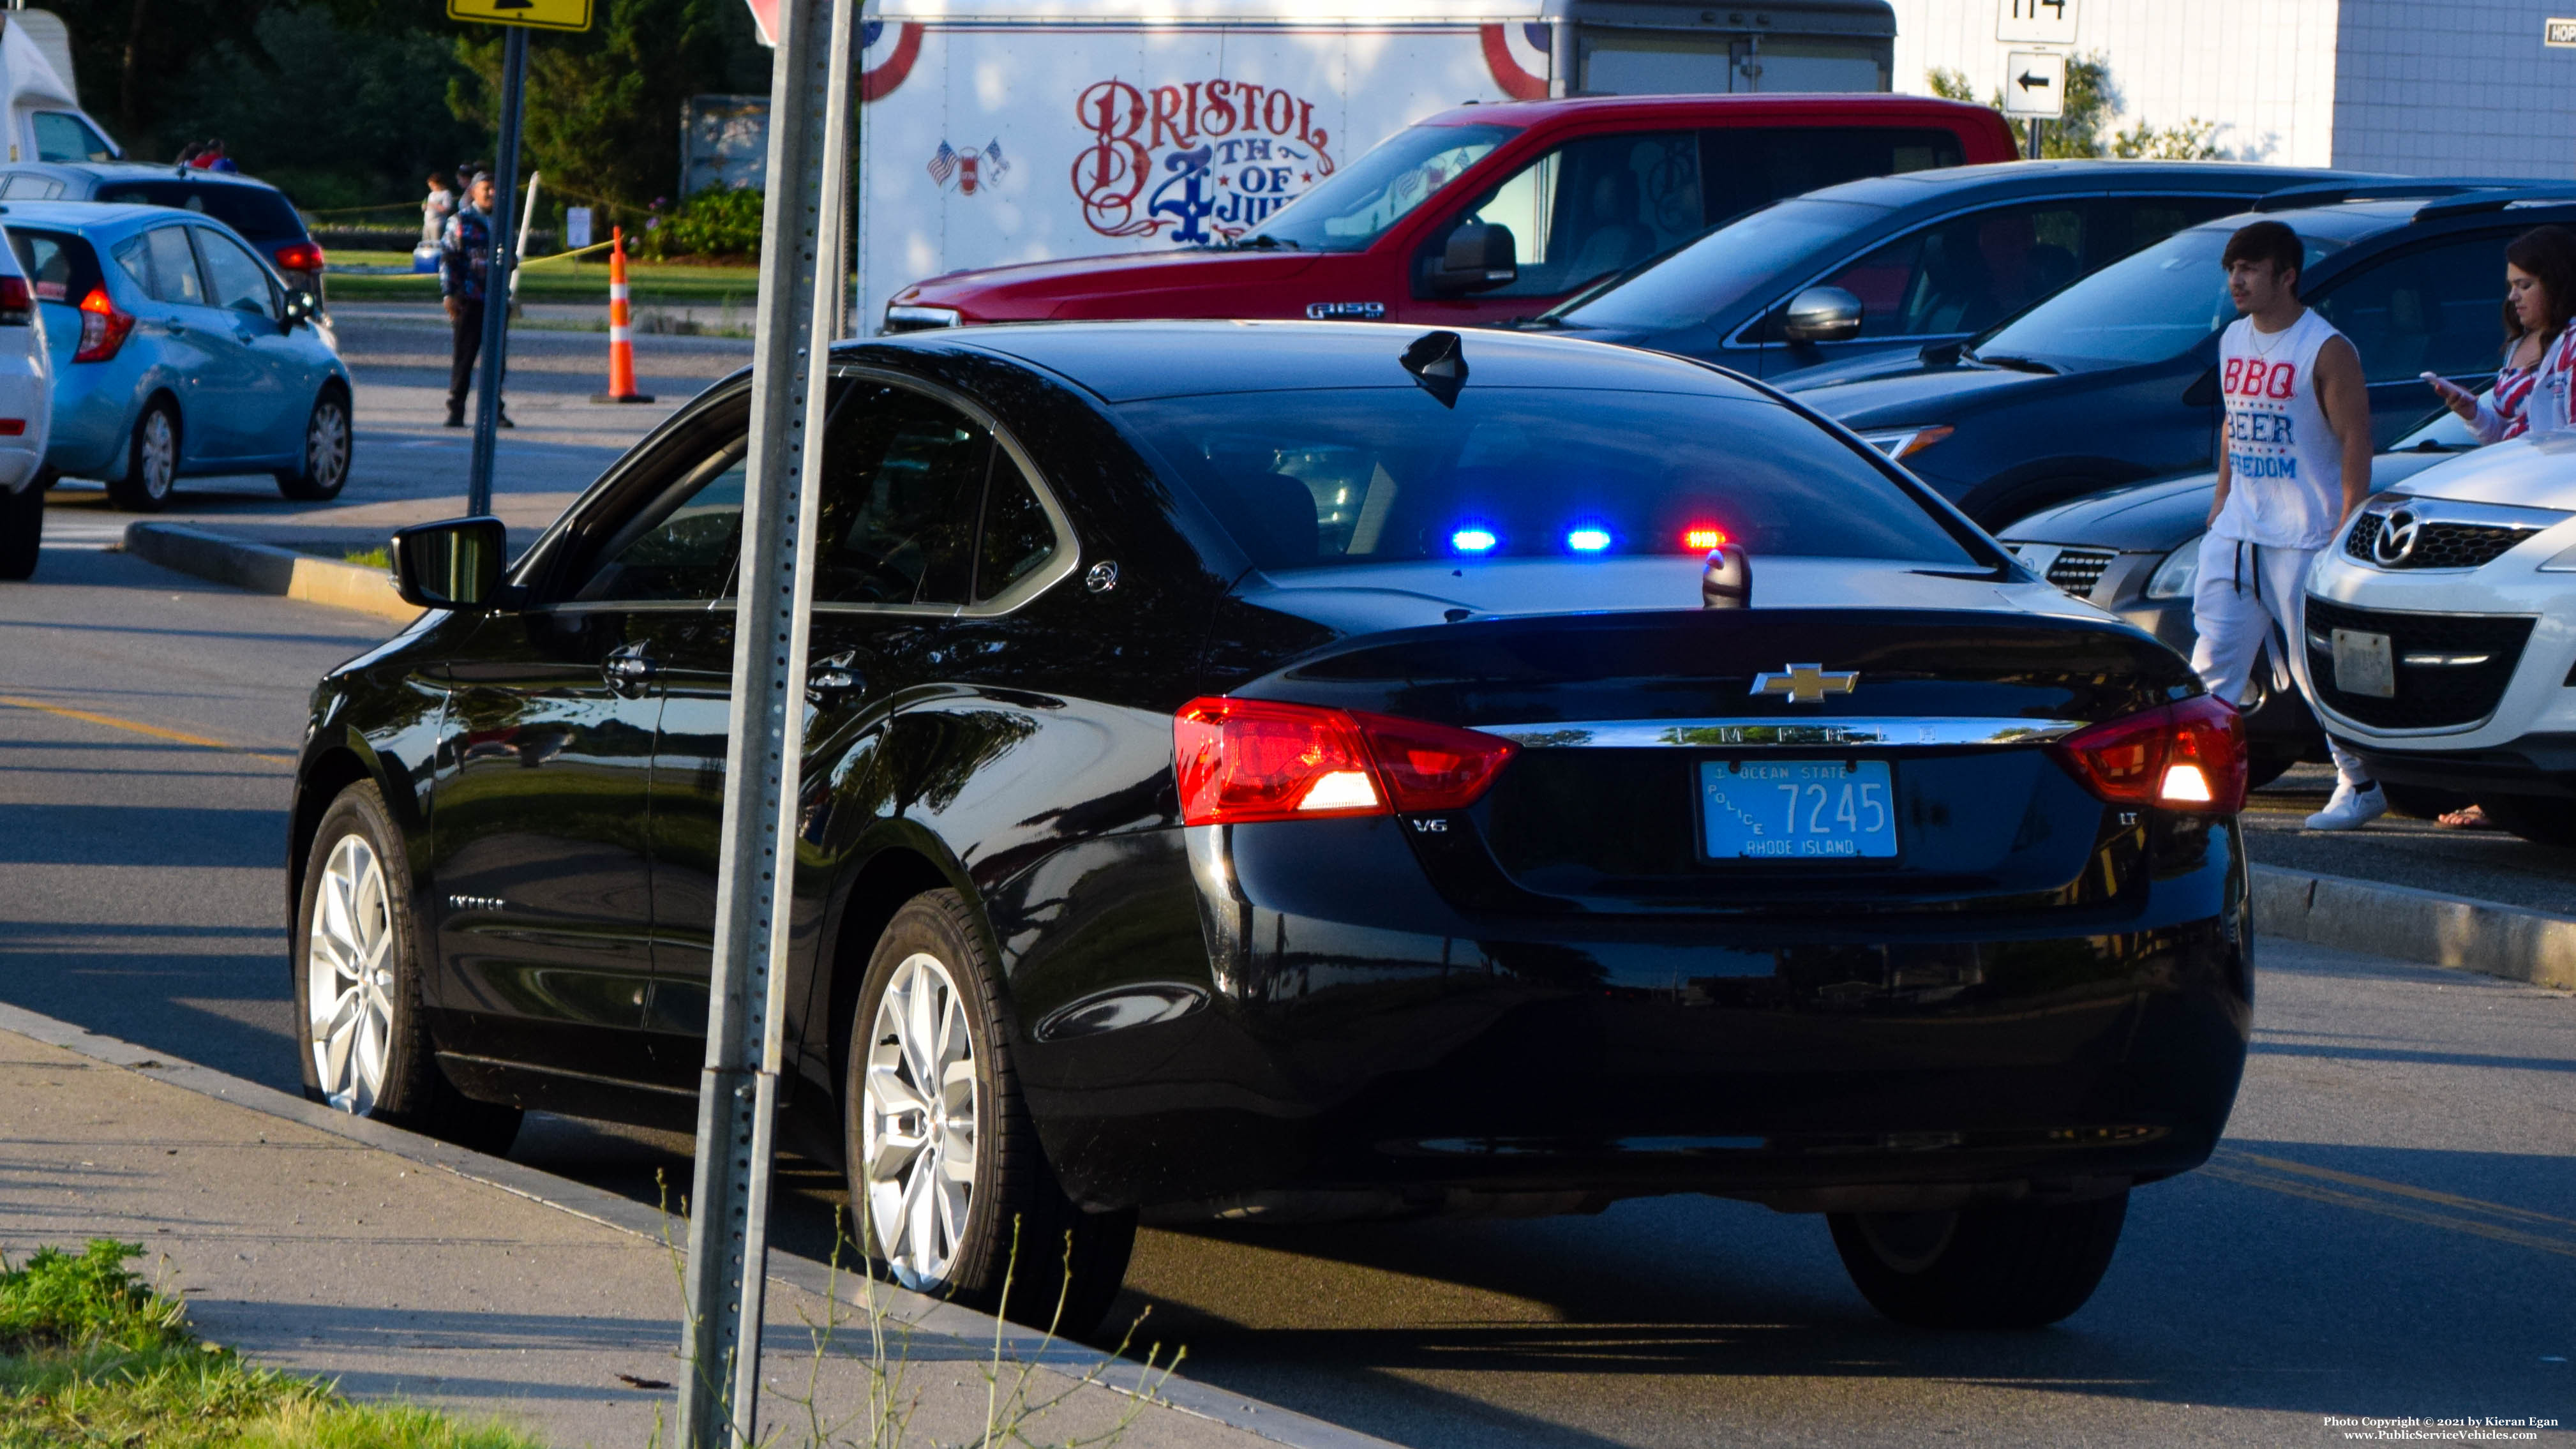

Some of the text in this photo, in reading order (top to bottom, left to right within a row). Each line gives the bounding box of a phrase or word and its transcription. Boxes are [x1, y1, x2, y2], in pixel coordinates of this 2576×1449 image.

[2551, 25, 2576, 41] HOP
[1071, 75, 1335, 237] BRISTOL
[1239, 166, 1292, 193] OF
[1216, 191, 1299, 226] JU
[2224, 357, 2298, 400] BBQ
[1740, 767, 1847, 779] OCEAN STATE
[1707, 785, 1764, 836] POLICE
[1778, 783, 1885, 834] 7245
[2120, 812, 2138, 825] LT
[1412, 819, 1448, 832] V6
[1746, 839, 1854, 855] RHODE ISLAND
